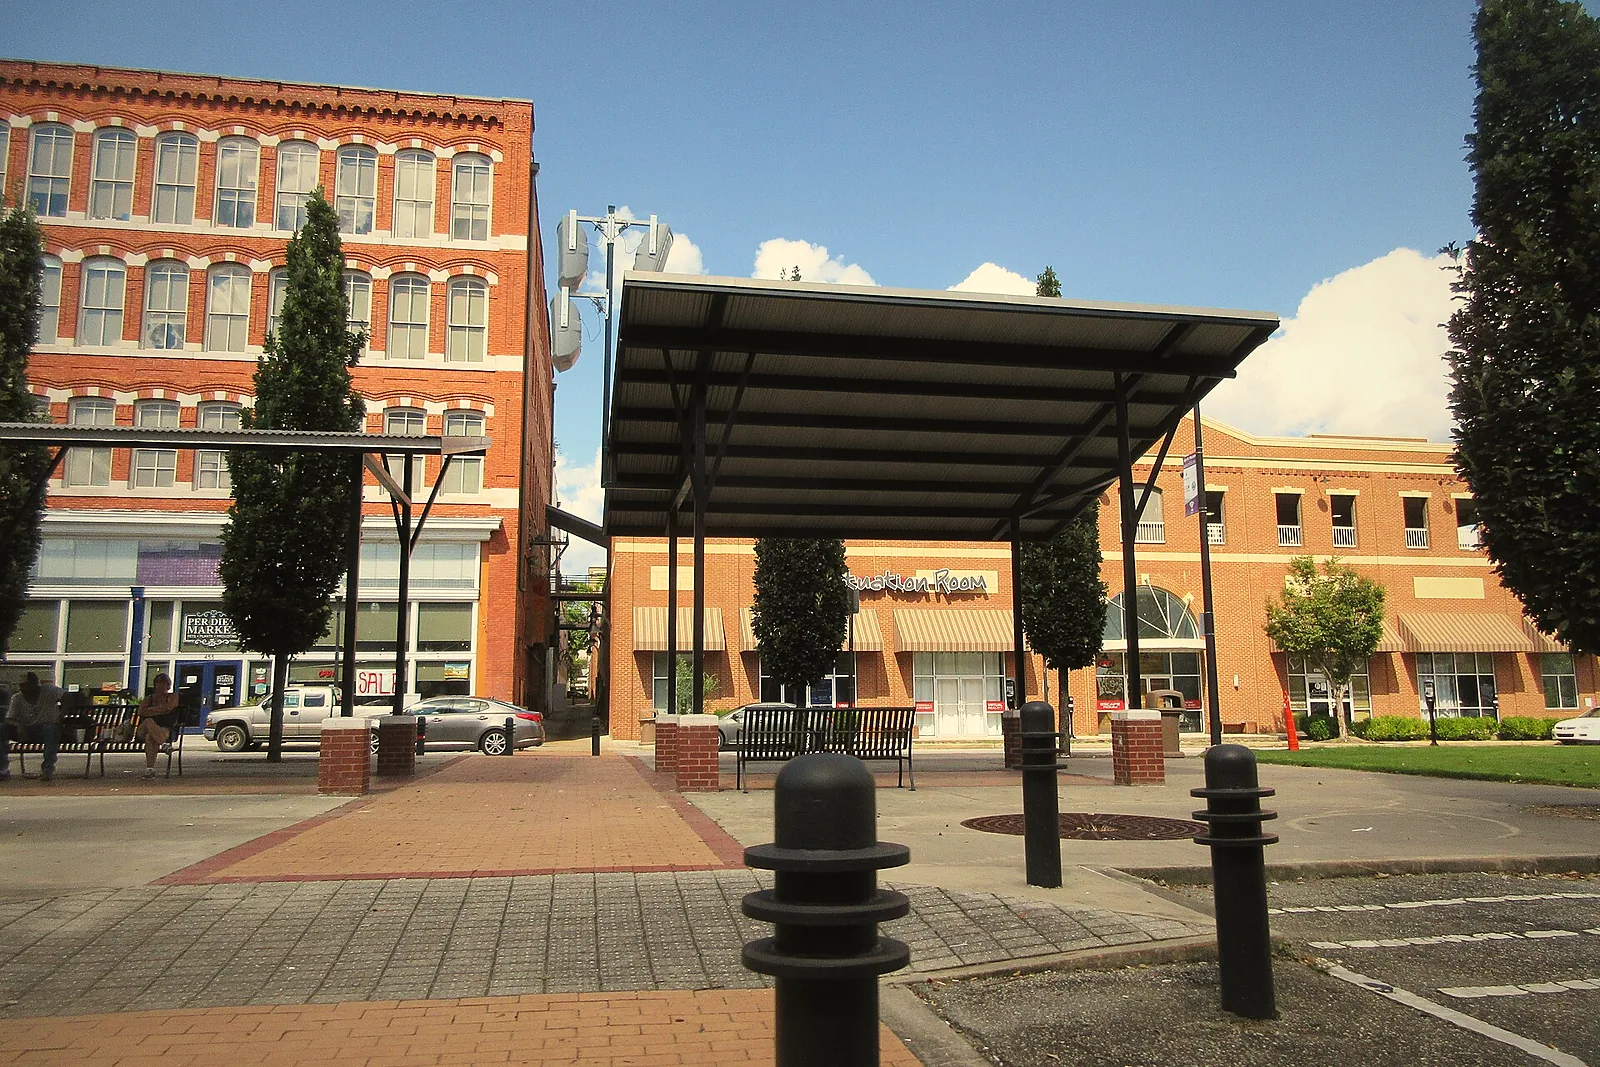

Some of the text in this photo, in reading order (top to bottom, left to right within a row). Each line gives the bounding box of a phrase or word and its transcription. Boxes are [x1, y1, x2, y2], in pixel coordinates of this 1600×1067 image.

[842, 570, 930, 592] tuation
[188, 618, 232, 626] PER DIE
